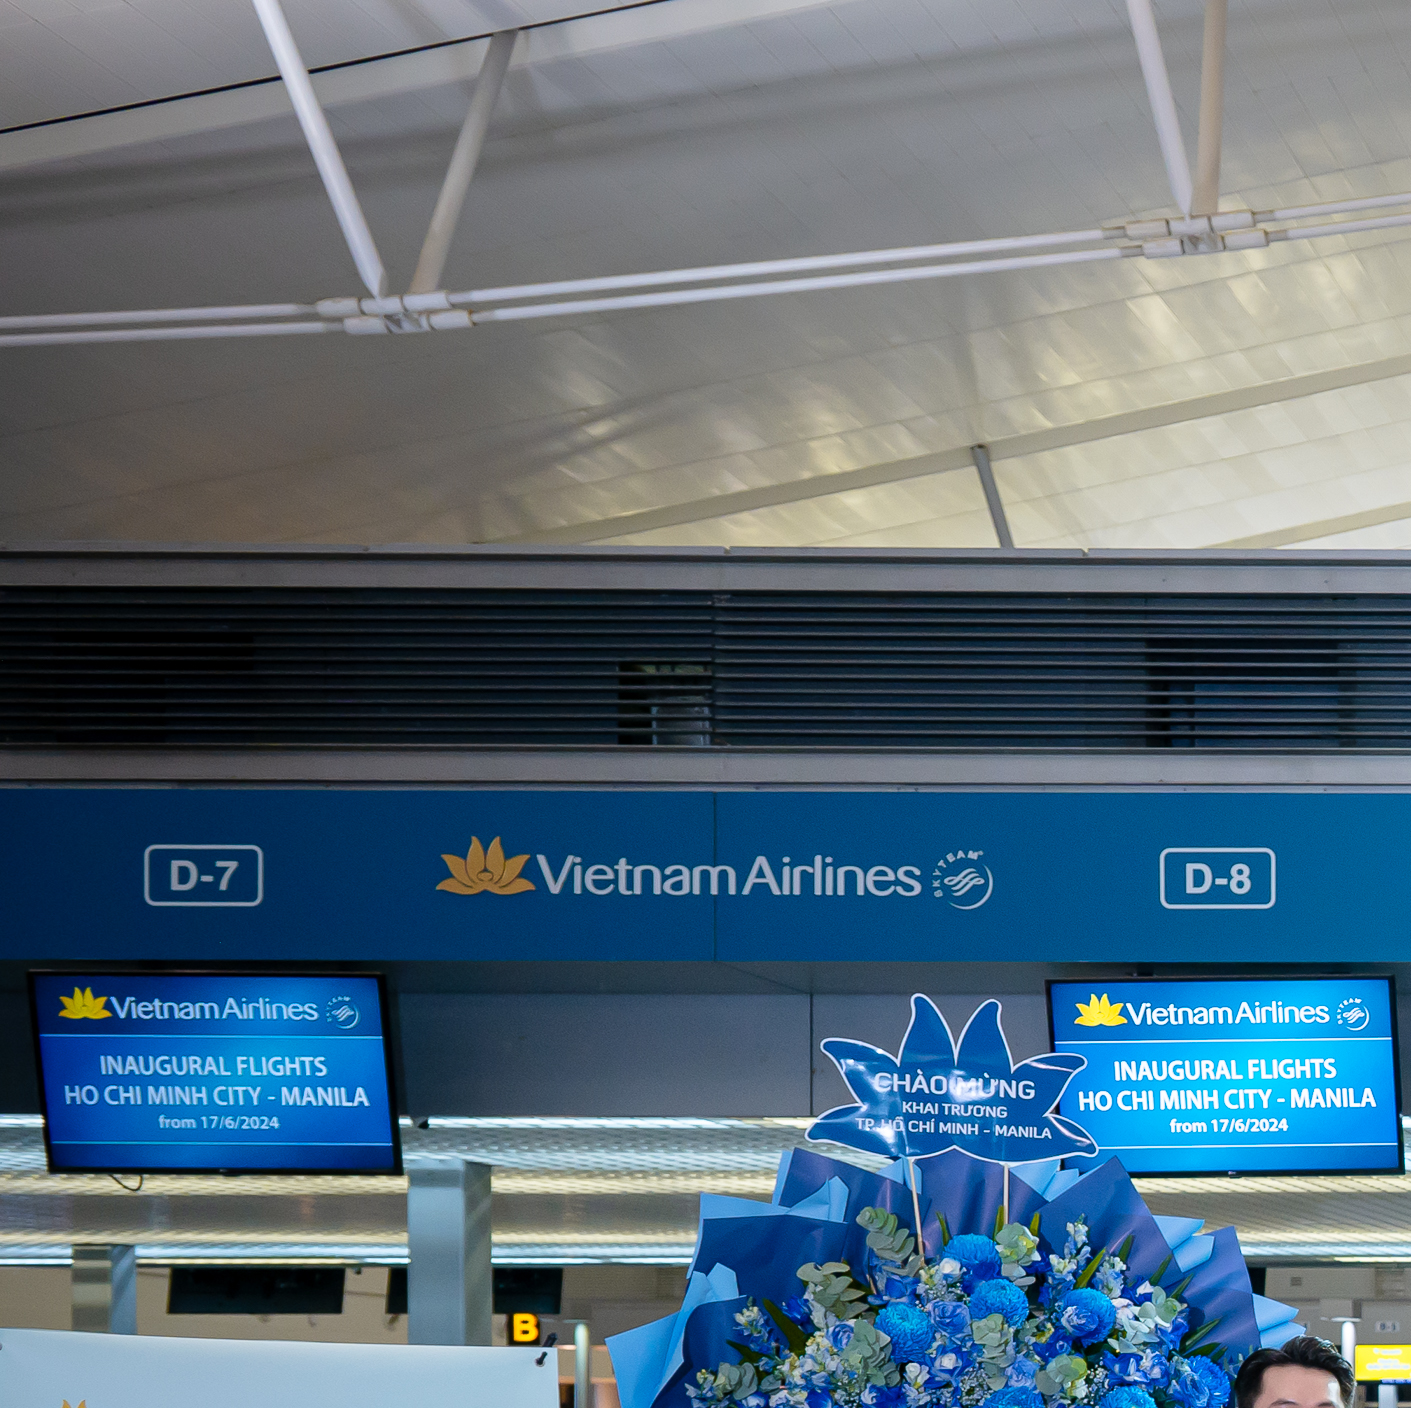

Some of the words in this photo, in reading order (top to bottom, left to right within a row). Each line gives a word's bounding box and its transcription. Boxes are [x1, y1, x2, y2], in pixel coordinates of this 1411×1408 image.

[169, 858, 238, 893] D-7
[536, 854, 737, 896] Vietnam
[741, 854, 922, 897] Airlines
[932, 849, 980, 899] SKYTEAM
[1184, 861, 1252, 895] D-8
[109, 996, 219, 1020] Vietnam
[222, 997, 319, 1022] Airlines
[1126, 1002, 1232, 1026] Vietnam
[1235, 1000, 1330, 1025] Airlines
[100, 1055, 231, 1076] INAUGURAL
[236, 1056, 327, 1077] FLIGHTS
[1114, 1059, 1243, 1081] INAUGURAL
[1248, 1058, 1337, 1079] FLIGHTS
[64, 1085, 99, 1105] HO
[104, 1085, 142, 1105] CHI
[148, 1085, 208, 1106] MINH
[213, 1086, 262, 1106] CITY
[281, 1086, 370, 1107] MANILA
[874, 1069, 948, 1094] CHÀO
[955, 1072, 1035, 1099] MỪNG
[902, 1101, 939, 1115] KHAI
[942, 1102, 1008, 1118] TRƯƠNG
[1078, 1090, 1112, 1111] HO
[1116, 1090, 1154, 1111] CHI
[1160, 1089, 1219, 1110] MINH
[1224, 1088, 1272, 1109] CITY
[1290, 1088, 1377, 1108] MANILA
[158, 1114, 196, 1129] from
[201, 1115, 280, 1130] 17/6/2024
[908, 1118, 935, 1133] CHÍ
[939, 1122, 979, 1136] MINH
[994, 1125, 1052, 1140] MANILA
[1170, 1118, 1207, 1133] from
[1211, 1117, 1288, 1133] 17/6/2024
[513, 1312, 539, 1342] B
